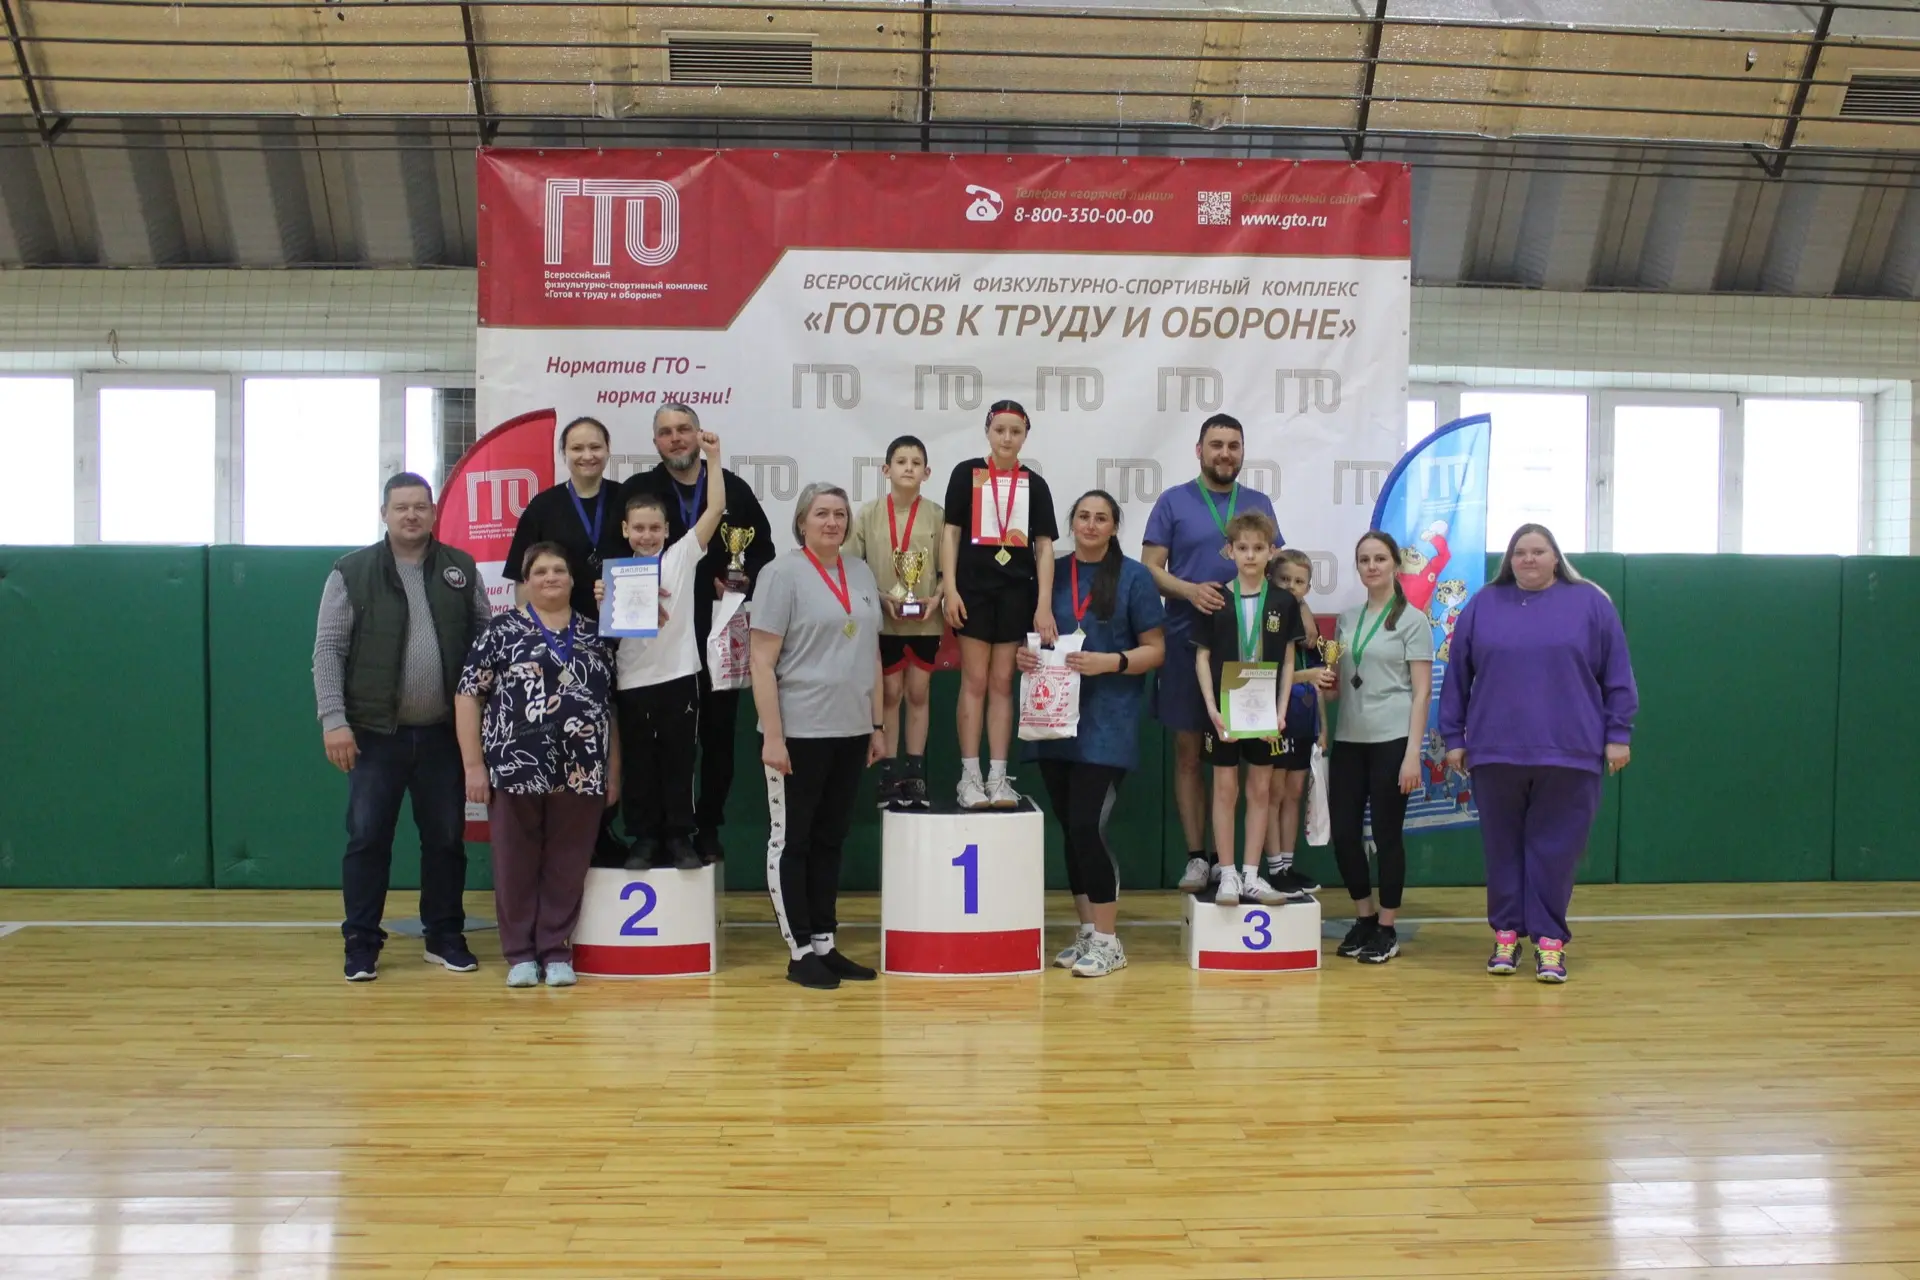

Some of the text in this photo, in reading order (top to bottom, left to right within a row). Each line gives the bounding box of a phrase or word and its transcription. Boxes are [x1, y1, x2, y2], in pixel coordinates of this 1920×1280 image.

[544, 178, 679, 267] ГТО
[1014, 207, 1154, 224] 8-800-350-00-00
[1241, 213, 1328, 230] www.gto.ru
[544, 270, 611, 280] Всероссийский
[544, 281, 708, 291] физкультурно-спортивный комплекс
[545, 290, 573, 299] «Готов
[582, 291, 608, 300] труду
[619, 290, 662, 300] обороне»
[803, 272, 1360, 297] ВСЕРОССИЙСКИЙ ФИЗКУЛЬТУРНО-СПОРТИВНЫЙ КОМПЛЕКС
[803, 302, 1357, 342] «ГОТОВ К ТРУДУ И ОБОРОНЕ»
[546, 356, 646, 378] Норматив
[652, 356, 690, 375] ГТО
[792, 363, 861, 410] ГТО
[914, 364, 983, 410] ГТО
[597, 387, 732, 407] норма жизни!
[1036, 366, 1104, 412] ГТО
[1157, 366, 1224, 412] ГТО
[1275, 368, 1342, 413] ГТО
[620, 566, 649, 574] ДИПЛОМ
[951, 844, 979, 914] 1
[619, 881, 659, 936] 2
[1241, 910, 1272, 951] 3
